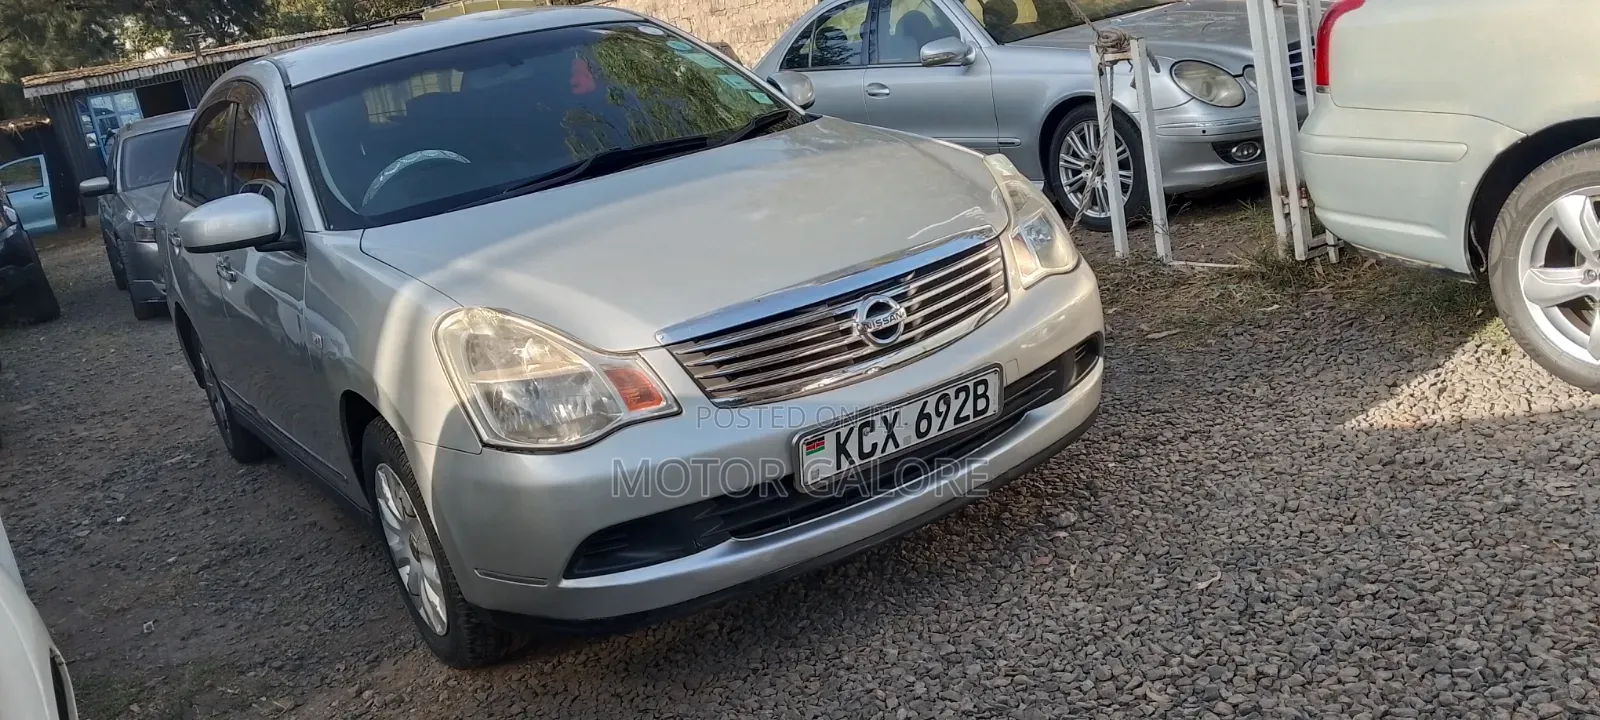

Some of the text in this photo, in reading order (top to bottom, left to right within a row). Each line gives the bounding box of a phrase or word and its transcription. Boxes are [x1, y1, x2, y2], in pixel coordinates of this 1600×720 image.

[863, 310, 905, 330] NISSAN
[835, 378, 990, 471] KCX 692B
